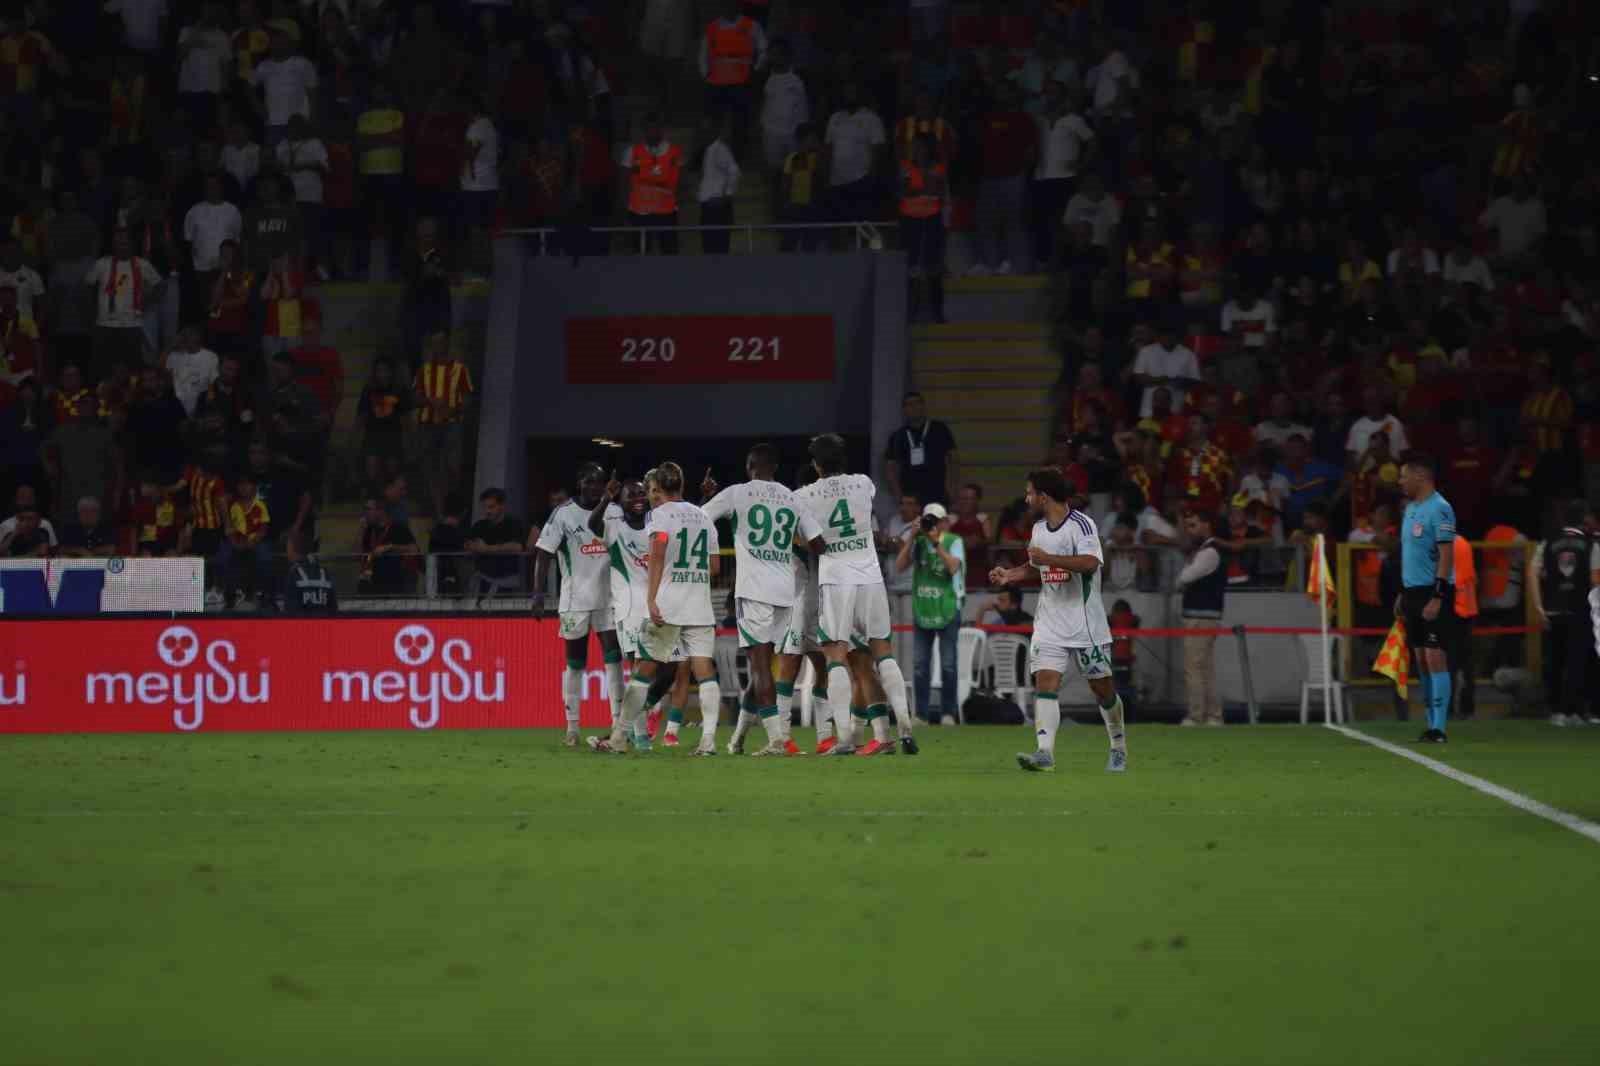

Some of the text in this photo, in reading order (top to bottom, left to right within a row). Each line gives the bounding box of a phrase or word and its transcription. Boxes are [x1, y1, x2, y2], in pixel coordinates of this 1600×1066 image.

[621, 336, 780, 362] 220 221
[747, 503, 796, 550] 93
[828, 498, 857, 537] 4
[673, 527, 709, 570] 14
